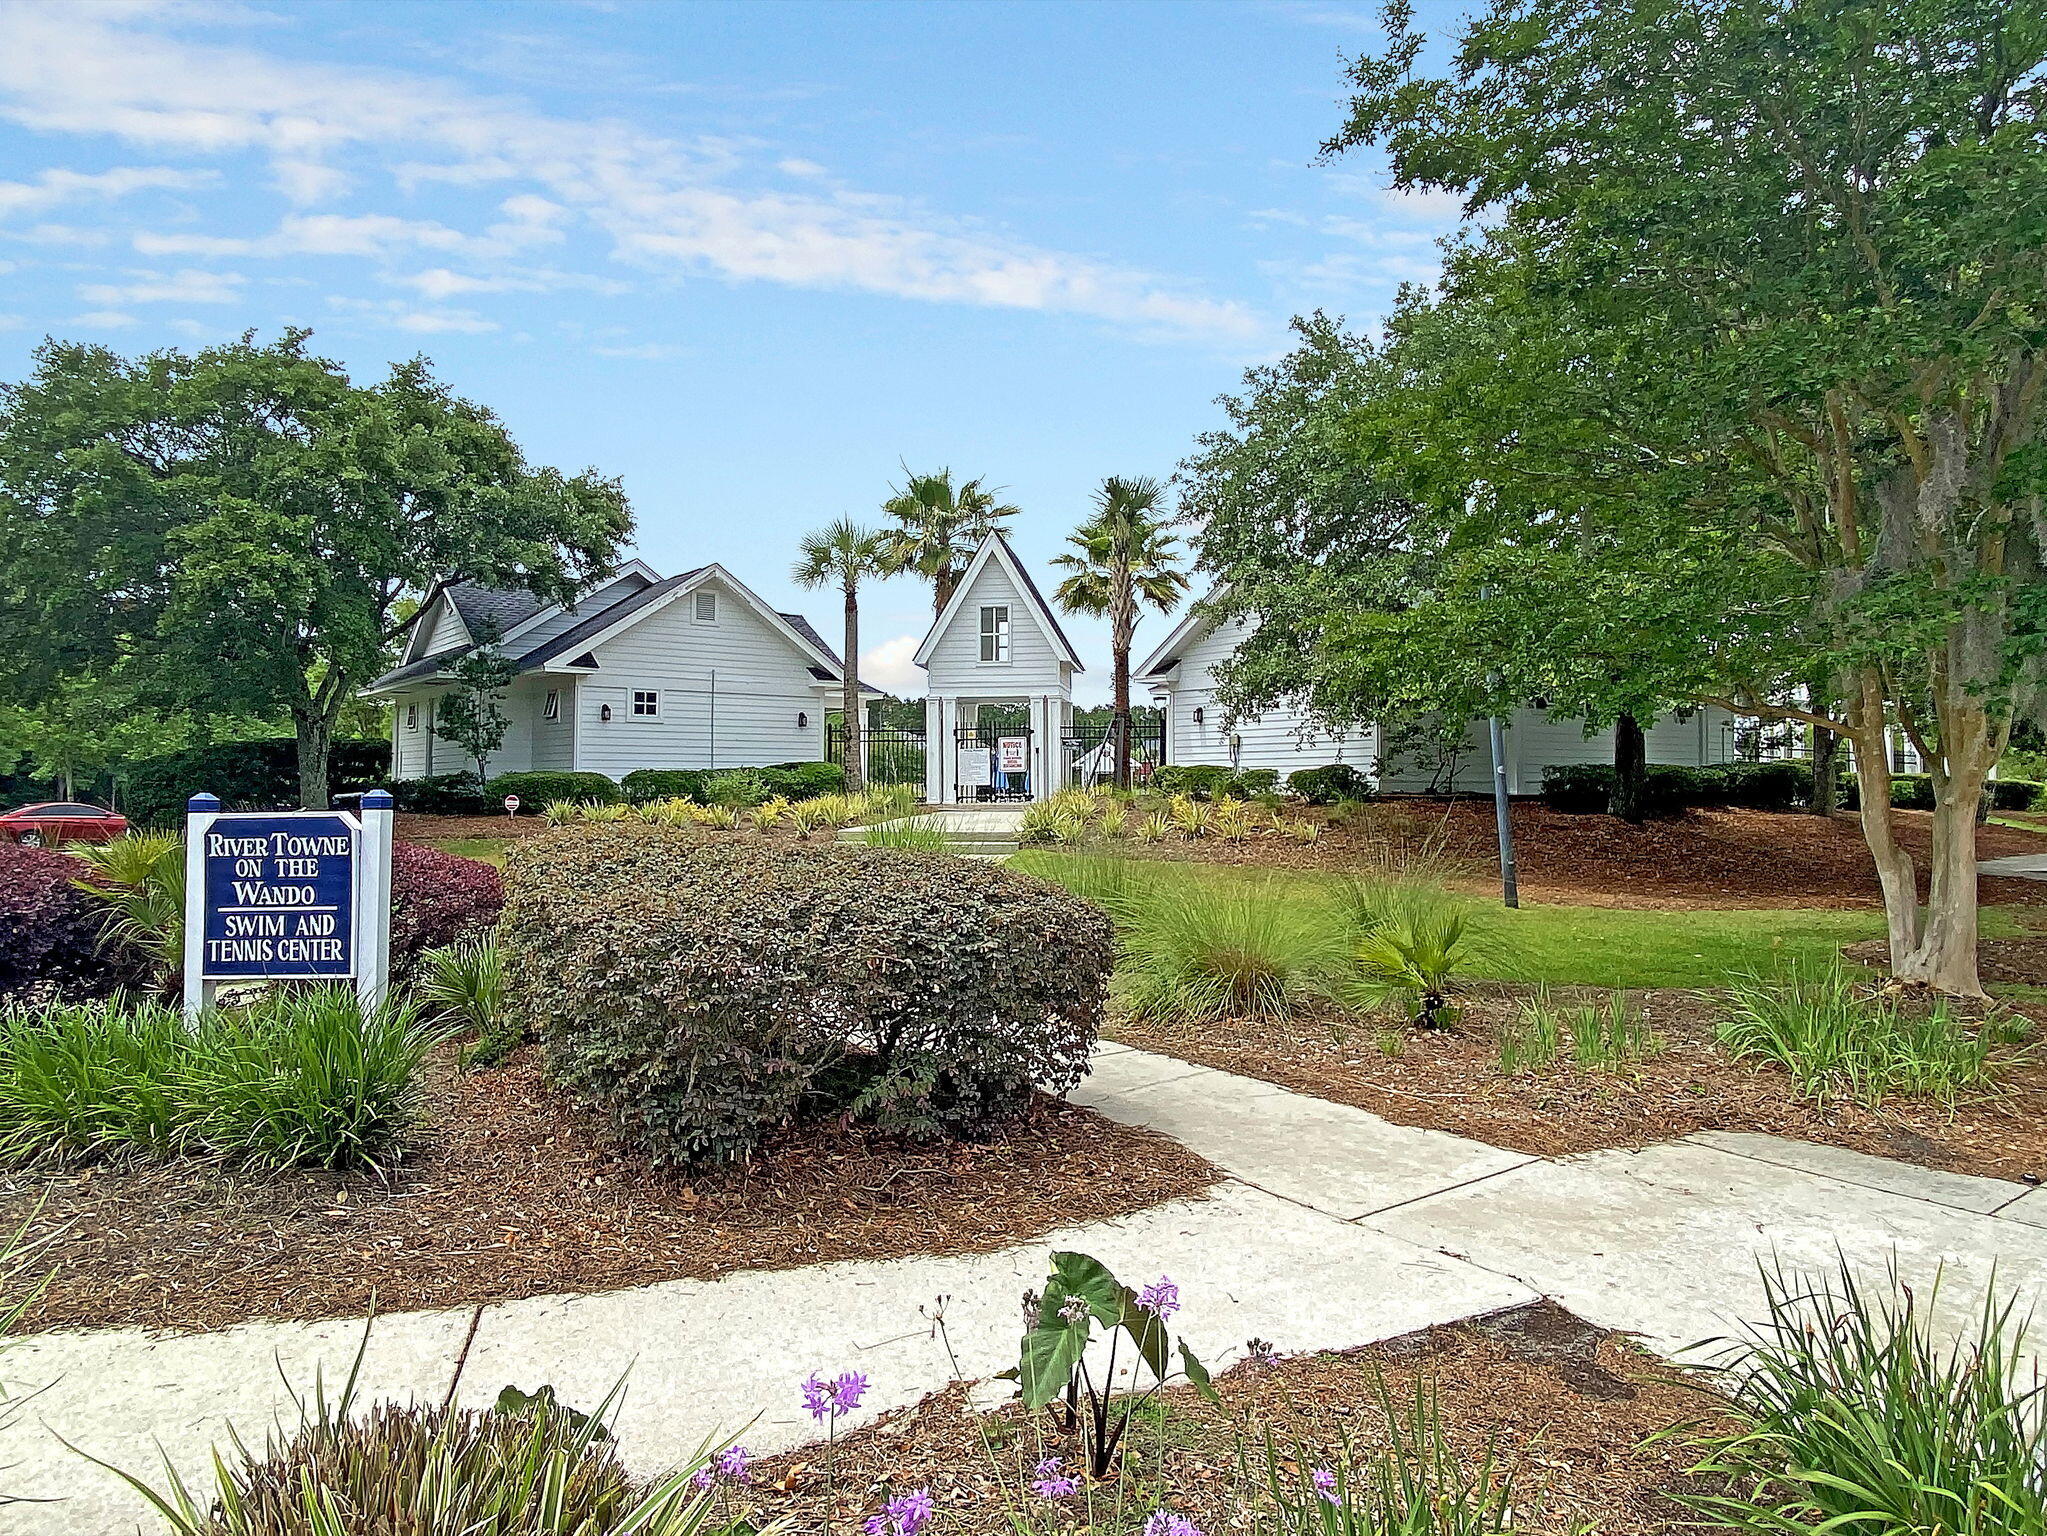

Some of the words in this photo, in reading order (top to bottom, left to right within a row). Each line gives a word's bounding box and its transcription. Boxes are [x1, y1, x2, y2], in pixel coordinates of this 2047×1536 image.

[208, 833, 270, 857] RIVER
[270, 833, 350, 856] TOWNE
[235, 859, 262, 877] ON
[274, 858, 319, 878] THE
[231, 881, 316, 905] WANDO
[225, 915, 285, 937] SWIM
[295, 914, 336, 937] AND
[207, 939, 273, 962] TENNIS
[277, 939, 344, 962] CENTER
